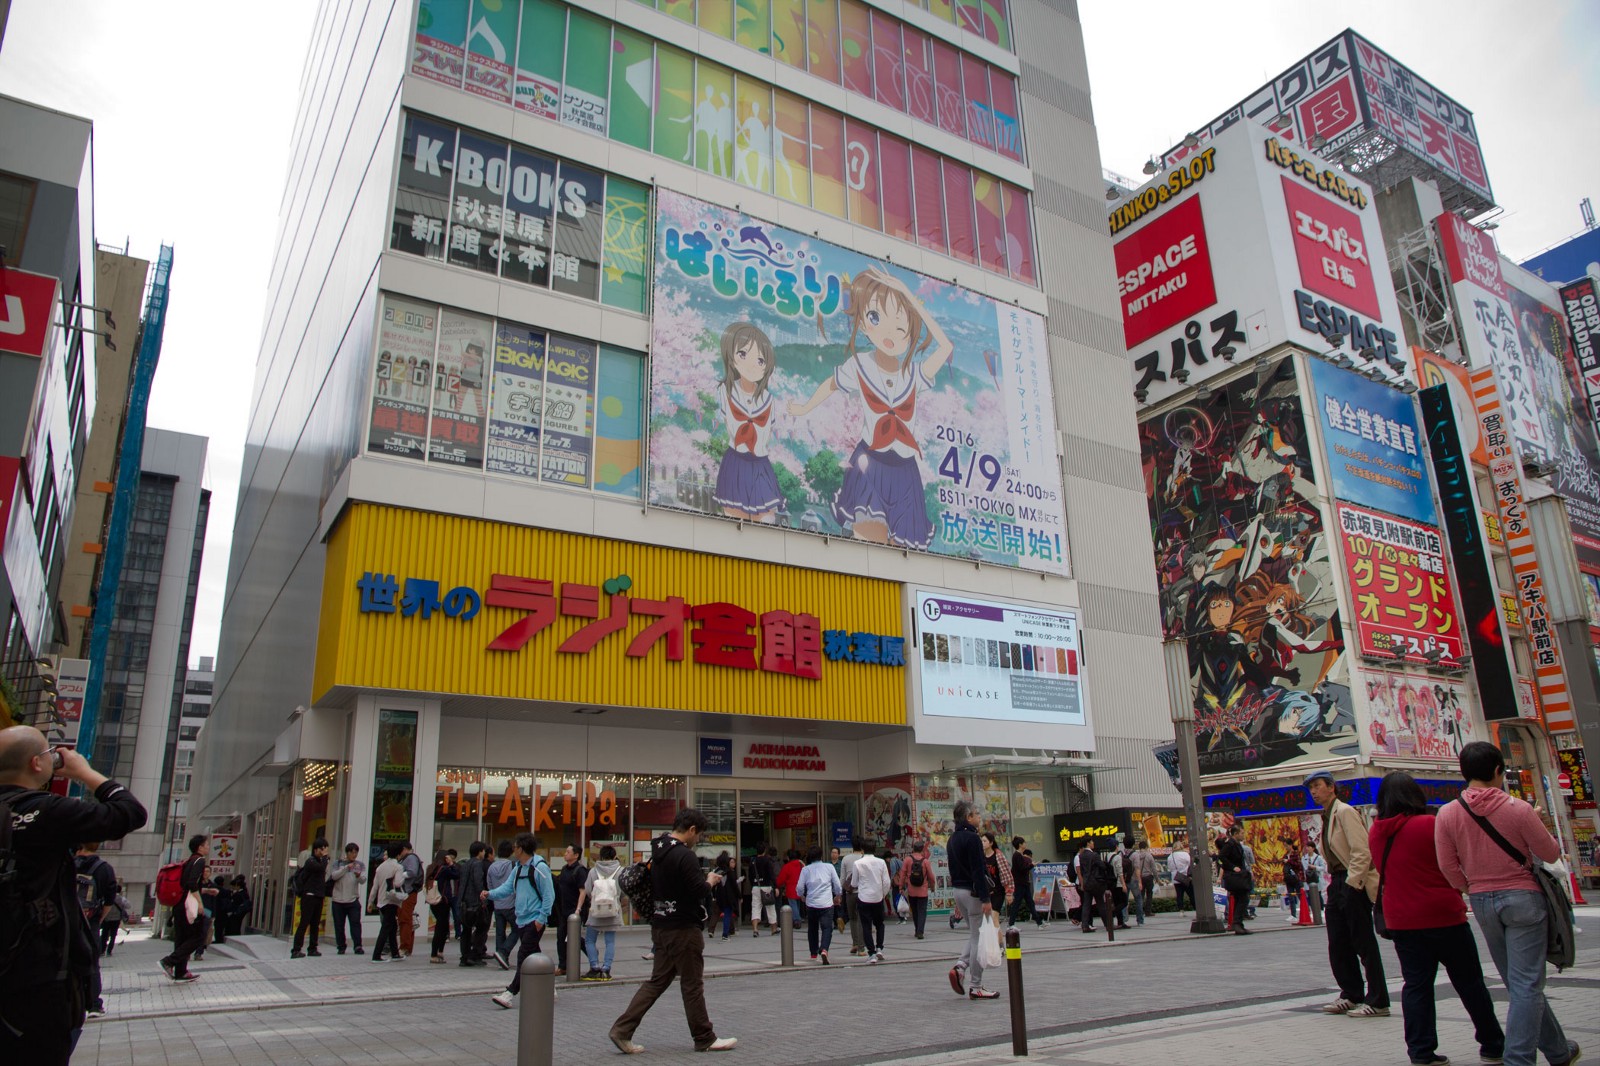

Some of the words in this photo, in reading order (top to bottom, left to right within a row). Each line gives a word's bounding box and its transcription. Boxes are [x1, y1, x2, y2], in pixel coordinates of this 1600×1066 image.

[564, 94, 605, 116] サンクス
[572, 107, 594, 120] 秋葉原
[1361, 69, 1419, 122] 秋葉原
[1392, 66, 1476, 139] ボークス
[414, 134, 587, 218] K-BOOKS
[455, 196, 545, 242] 秋葉原
[1295, 210, 1368, 266] エスパス
[666, 228, 840, 317] はいふり
[1322, 256, 1357, 289] 日拓
[1127, 272, 1188, 317] NITTAKU
[1294, 289, 1401, 367] ESPACE
[1563, 287, 1597, 369] PARADISE
[496, 345, 589, 381] BIGMAGIC
[504, 412, 527, 422] TOYS
[507, 391, 575, 421] 宇宙船
[1325, 393, 1418, 456] 健全営業宣言
[384, 437, 467, 458] JUNGLE
[384, 444, 410, 453] ジャングル
[936, 425, 974, 447] 2016
[1484, 413, 1507, 458] 買取り
[939, 446, 1001, 492] 4/9
[1498, 480, 1523, 535] まっくす
[1342, 510, 1441, 555] 赤坂見附駅前店
[1353, 558, 1447, 603] グランド
[1358, 592, 1452, 634] オープン
[1520, 572, 1556, 666] アキバ駅前店
[823, 629, 907, 666] 秋葉原
[1371, 631, 1391, 642] パチンコ
[1373, 640, 1391, 650] スロット
[1391, 634, 1453, 660] エスパス
[59, 684, 83, 692] アコム
[743, 757, 826, 771] RADIOKAIKAN
[749, 743, 821, 757] AKIHABARA
[436, 786, 488, 820] The
